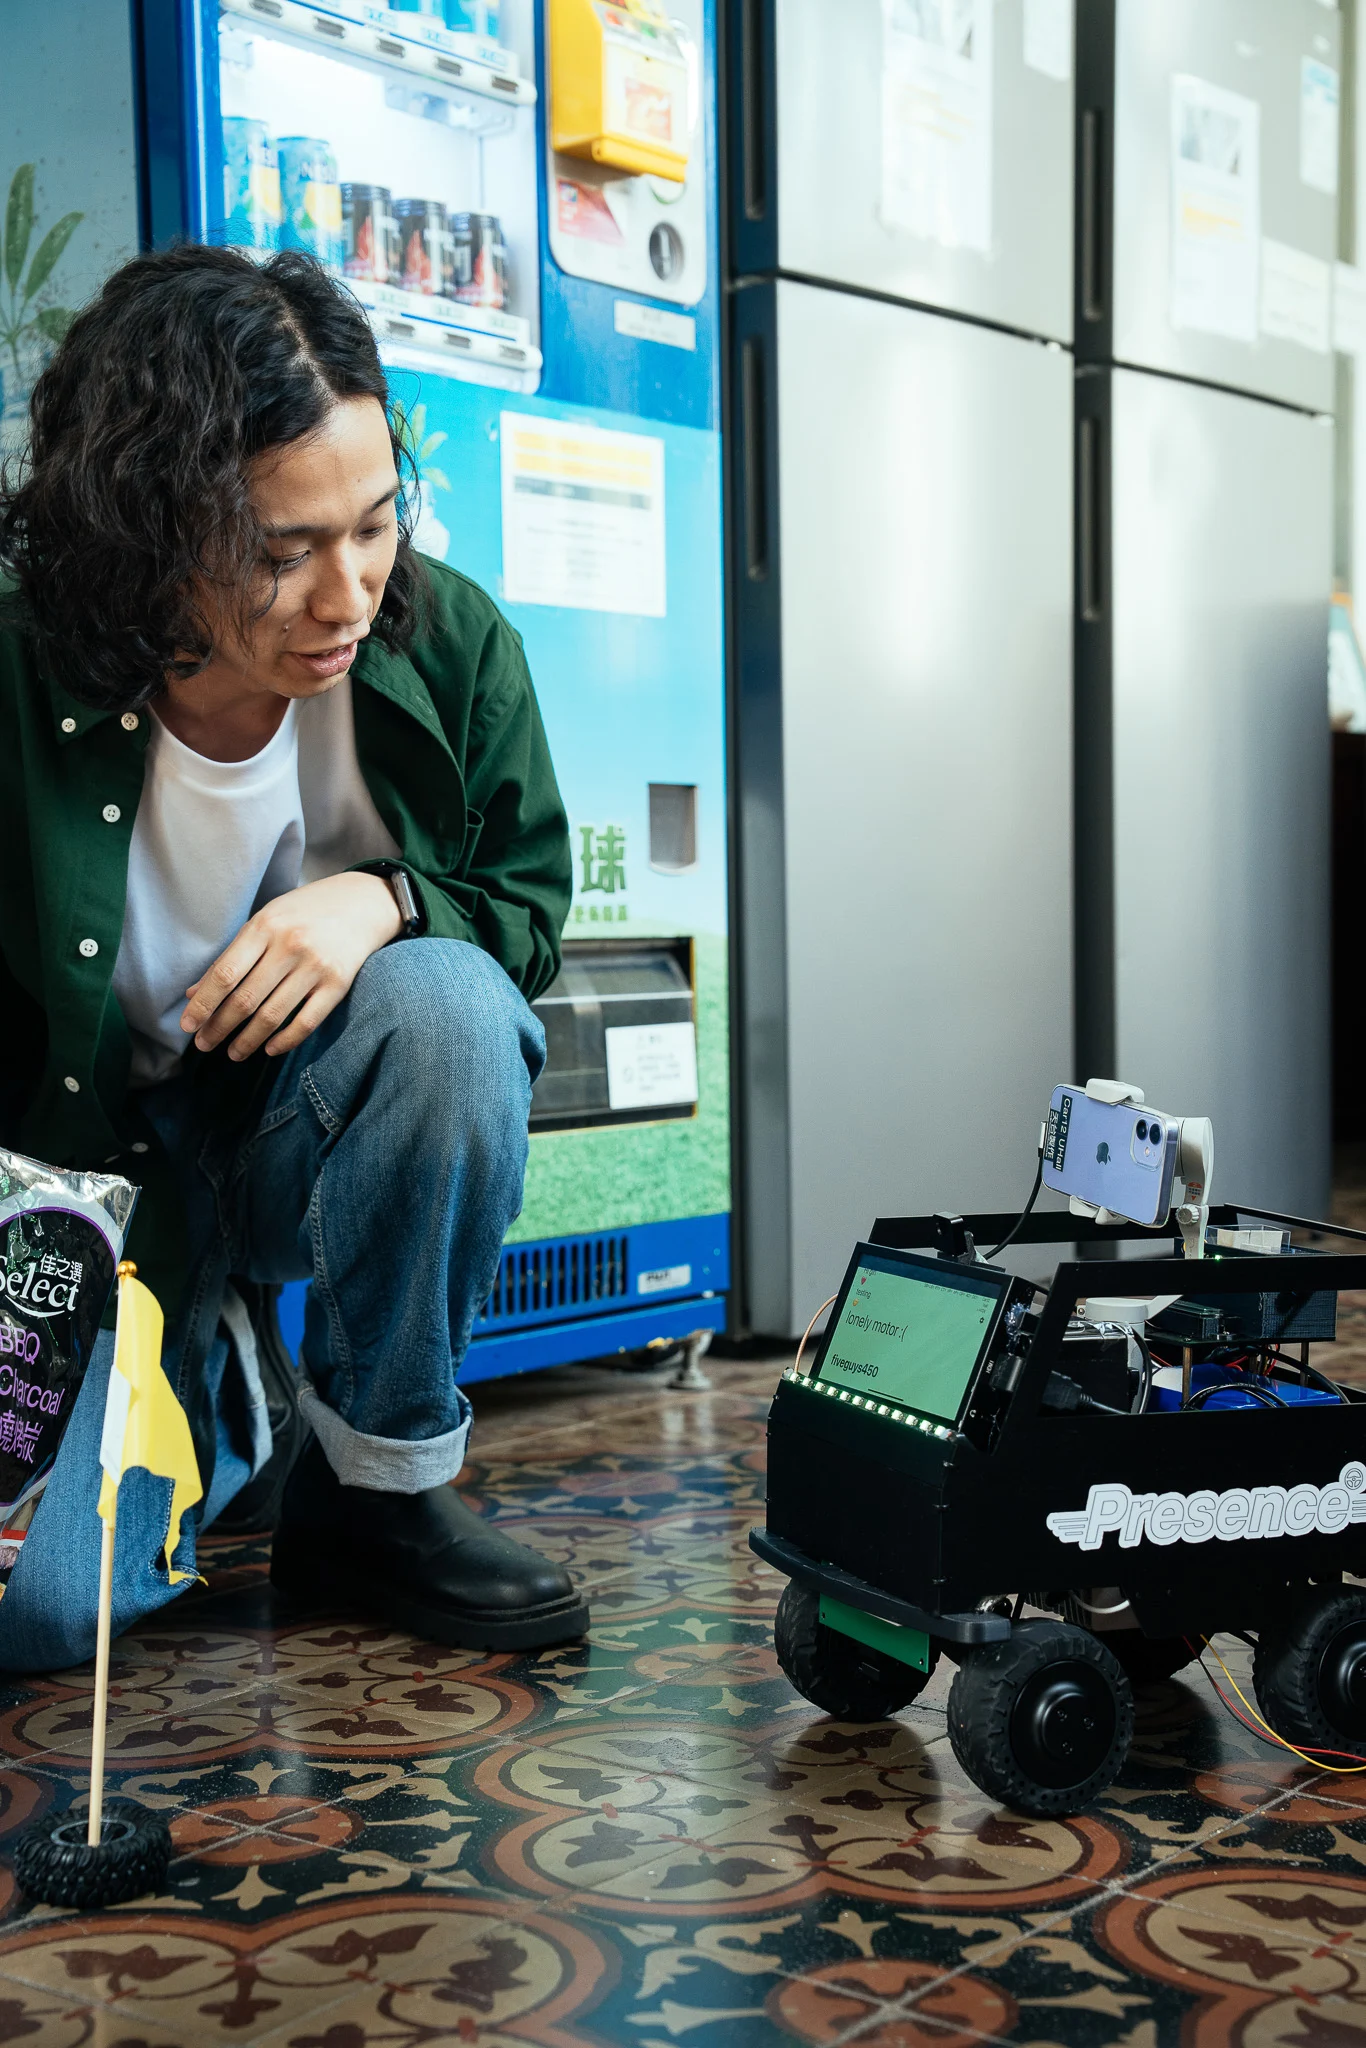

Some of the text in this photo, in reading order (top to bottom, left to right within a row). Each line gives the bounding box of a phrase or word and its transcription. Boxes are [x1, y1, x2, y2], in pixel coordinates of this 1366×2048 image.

[579, 825, 626, 893] 球
[1060, 1098, 1071, 1134] Car12
[40, 1253, 83, 1283] 佳之選
[856, 1288, 872, 1300] testing
[845, 1310, 872, 1332] lonely
[871, 1320, 899, 1338] motor
[0, 1324, 40, 1365] BBQ
[830, 1353, 879, 1378] fiveguys450
[0, 1365, 65, 1415] Charcoal
[1084, 1488, 1350, 1544] Presence
